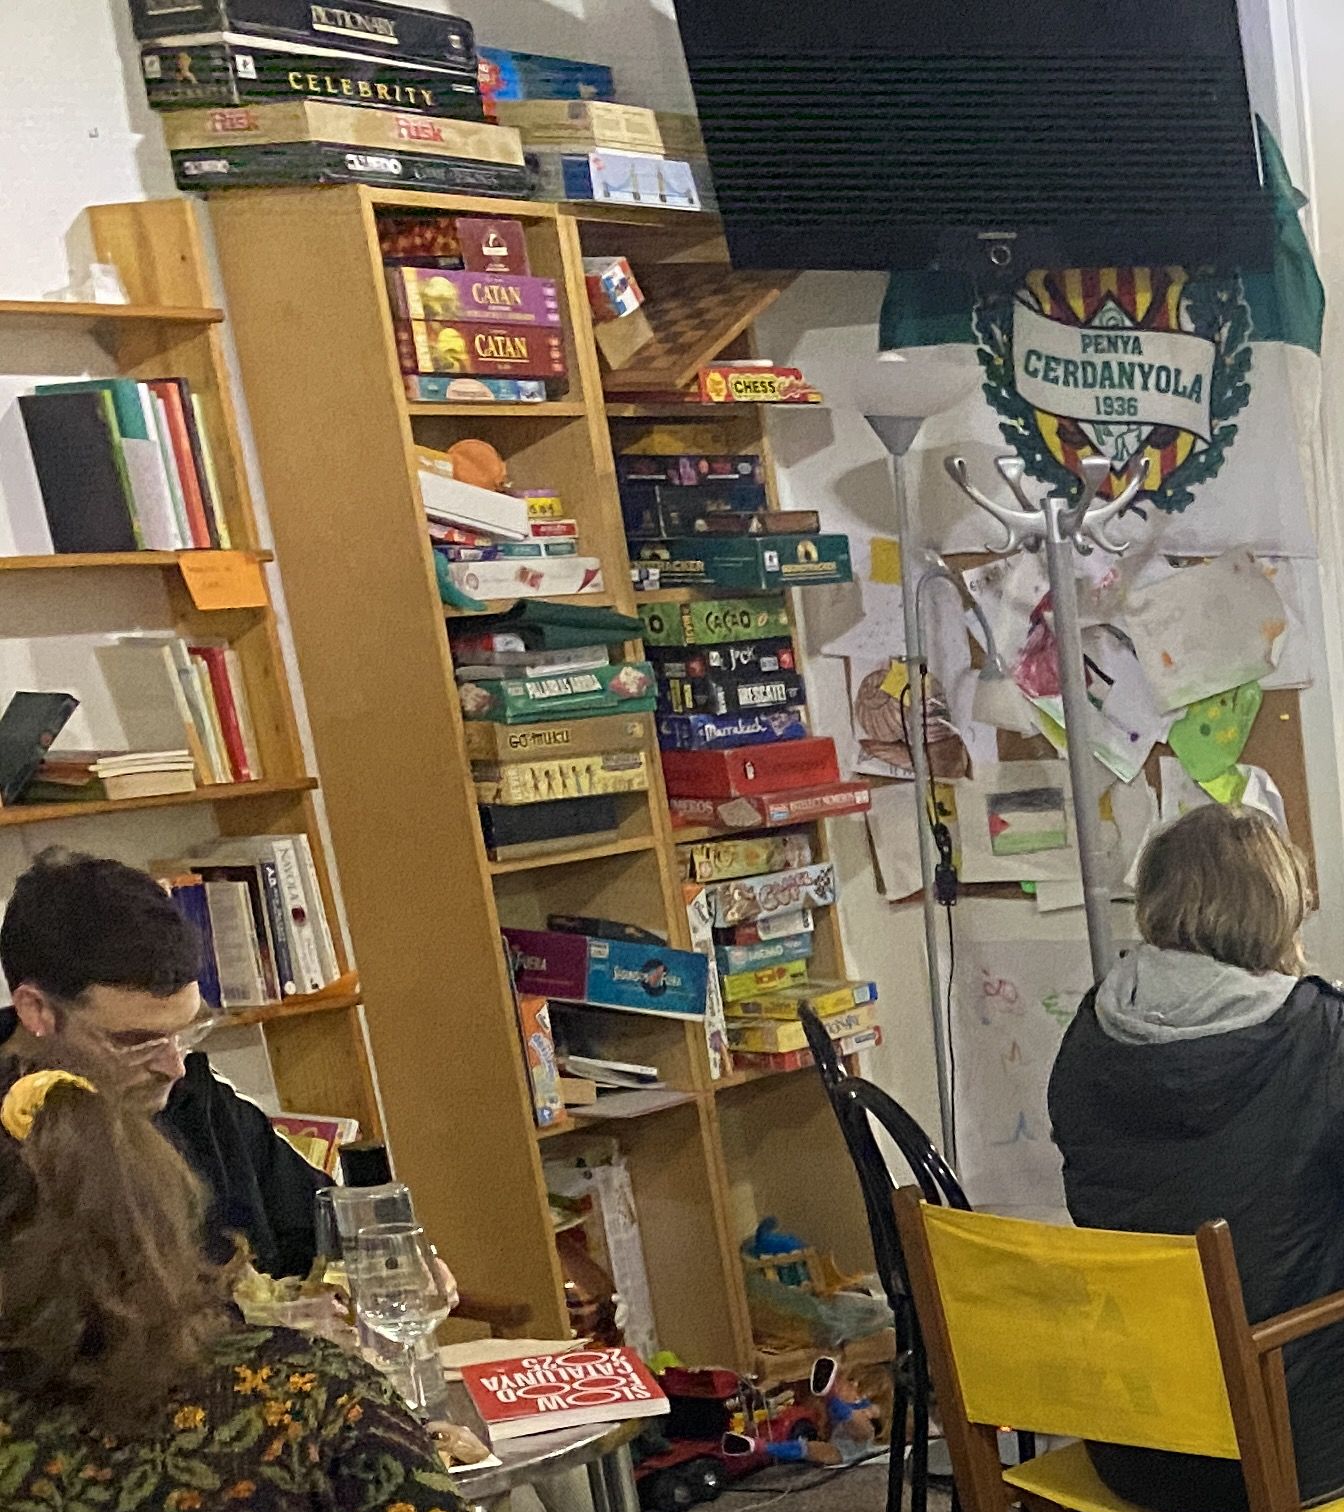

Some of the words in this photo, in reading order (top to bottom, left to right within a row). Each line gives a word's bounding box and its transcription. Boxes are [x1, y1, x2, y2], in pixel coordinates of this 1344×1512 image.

[289, 71, 434, 106] CELEBRITY
[472, 282, 522, 305] CATAN
[475, 333, 530, 359] CATAN
[1080, 334, 1143, 356] PENYA
[733, 380, 776, 394] CHESS
[1023, 349, 1204, 403] CERDANYOLA
[1096, 396, 1138, 417] 1936
[704, 717, 768, 742] Marrakech
[479, 1355, 635, 1393] CATALUNYA
